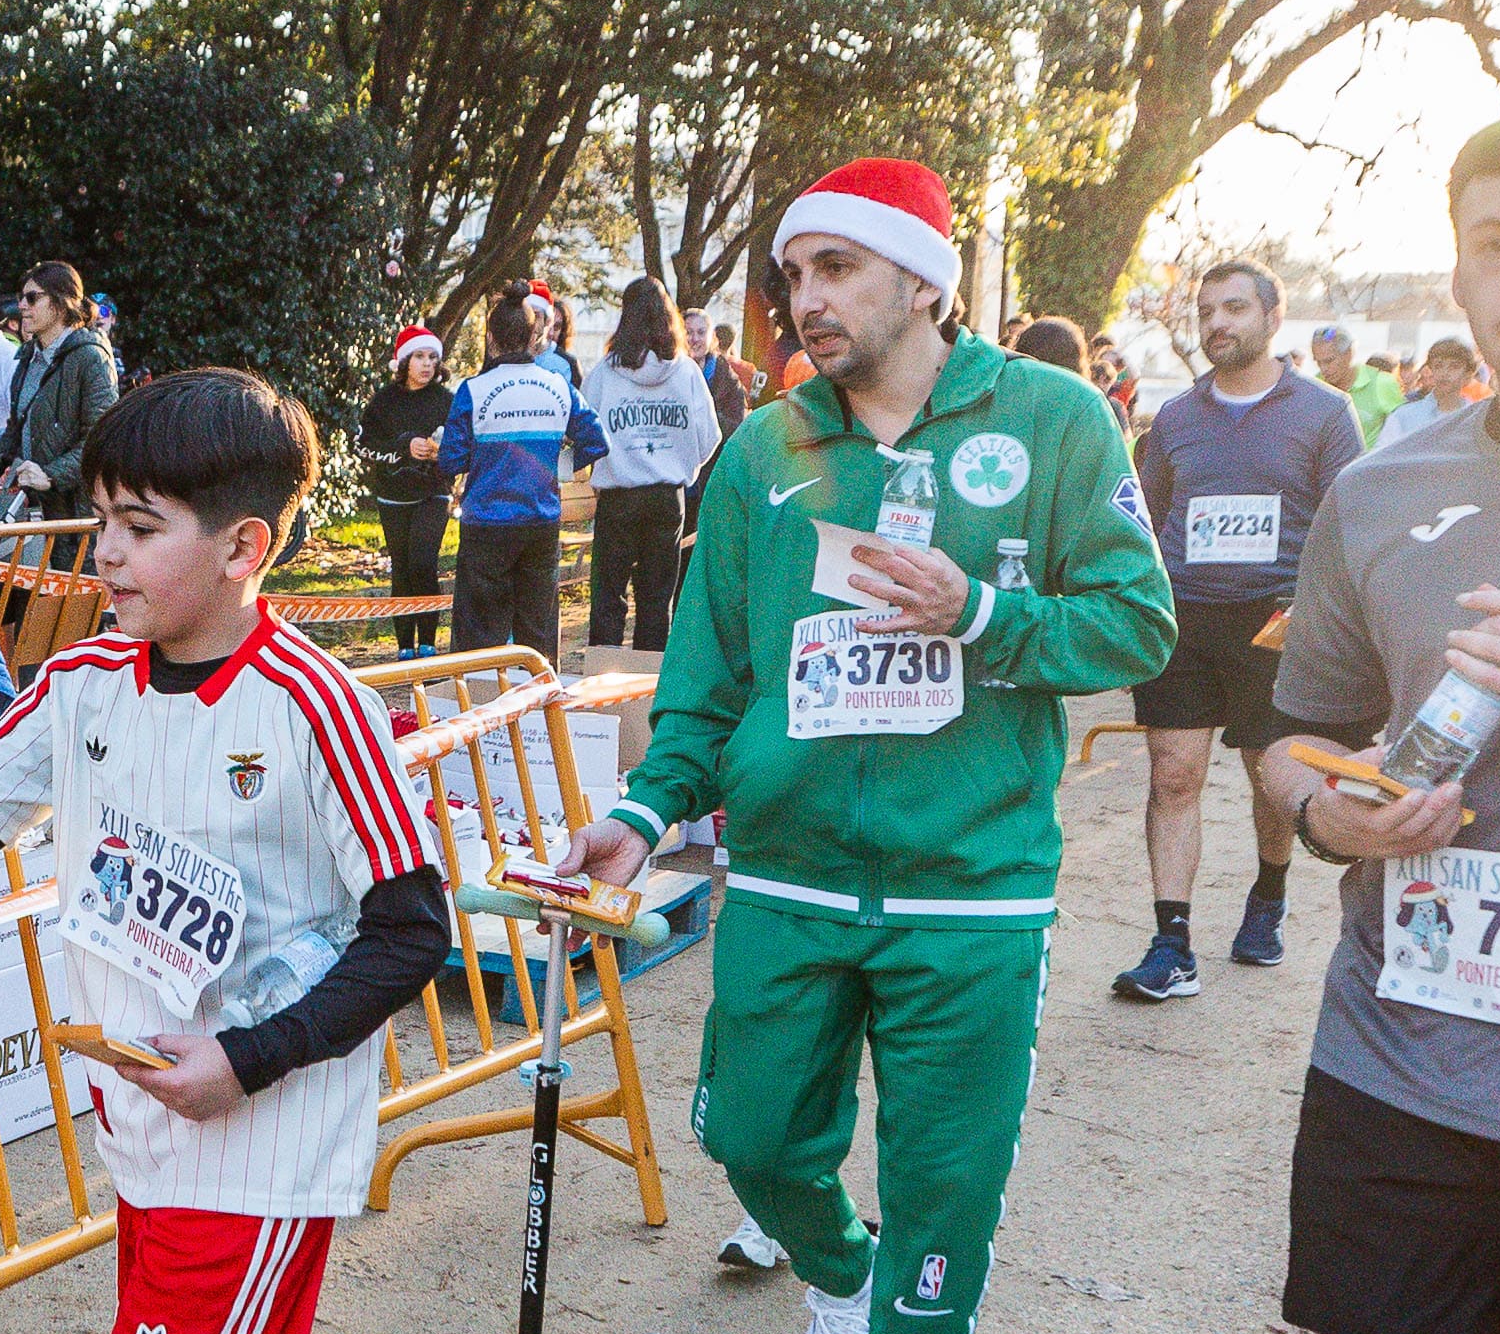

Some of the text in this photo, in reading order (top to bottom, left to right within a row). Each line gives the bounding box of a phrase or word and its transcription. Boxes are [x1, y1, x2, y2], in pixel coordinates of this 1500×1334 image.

[494, 409, 556, 420] PONTEVEDRA
[608, 405, 640, 433] GOOD
[642, 404, 689, 430] STORIES
[957, 437, 1025, 465] CELTICS
[890, 512, 921, 525] FROIZ
[1218, 514, 1273, 536] 2234
[847, 640, 952, 686] 3730
[845, 689, 954, 709] PONTEVEDRA 2025
[132, 821, 166, 864] SAN
[165, 842, 243, 915] SILVESTRE
[1440, 855, 1483, 893] SAN
[136, 867, 234, 966] 3728
[126, 918, 195, 980] PONTEVEDRA
[523, 1141, 550, 1296] GLOBBER
